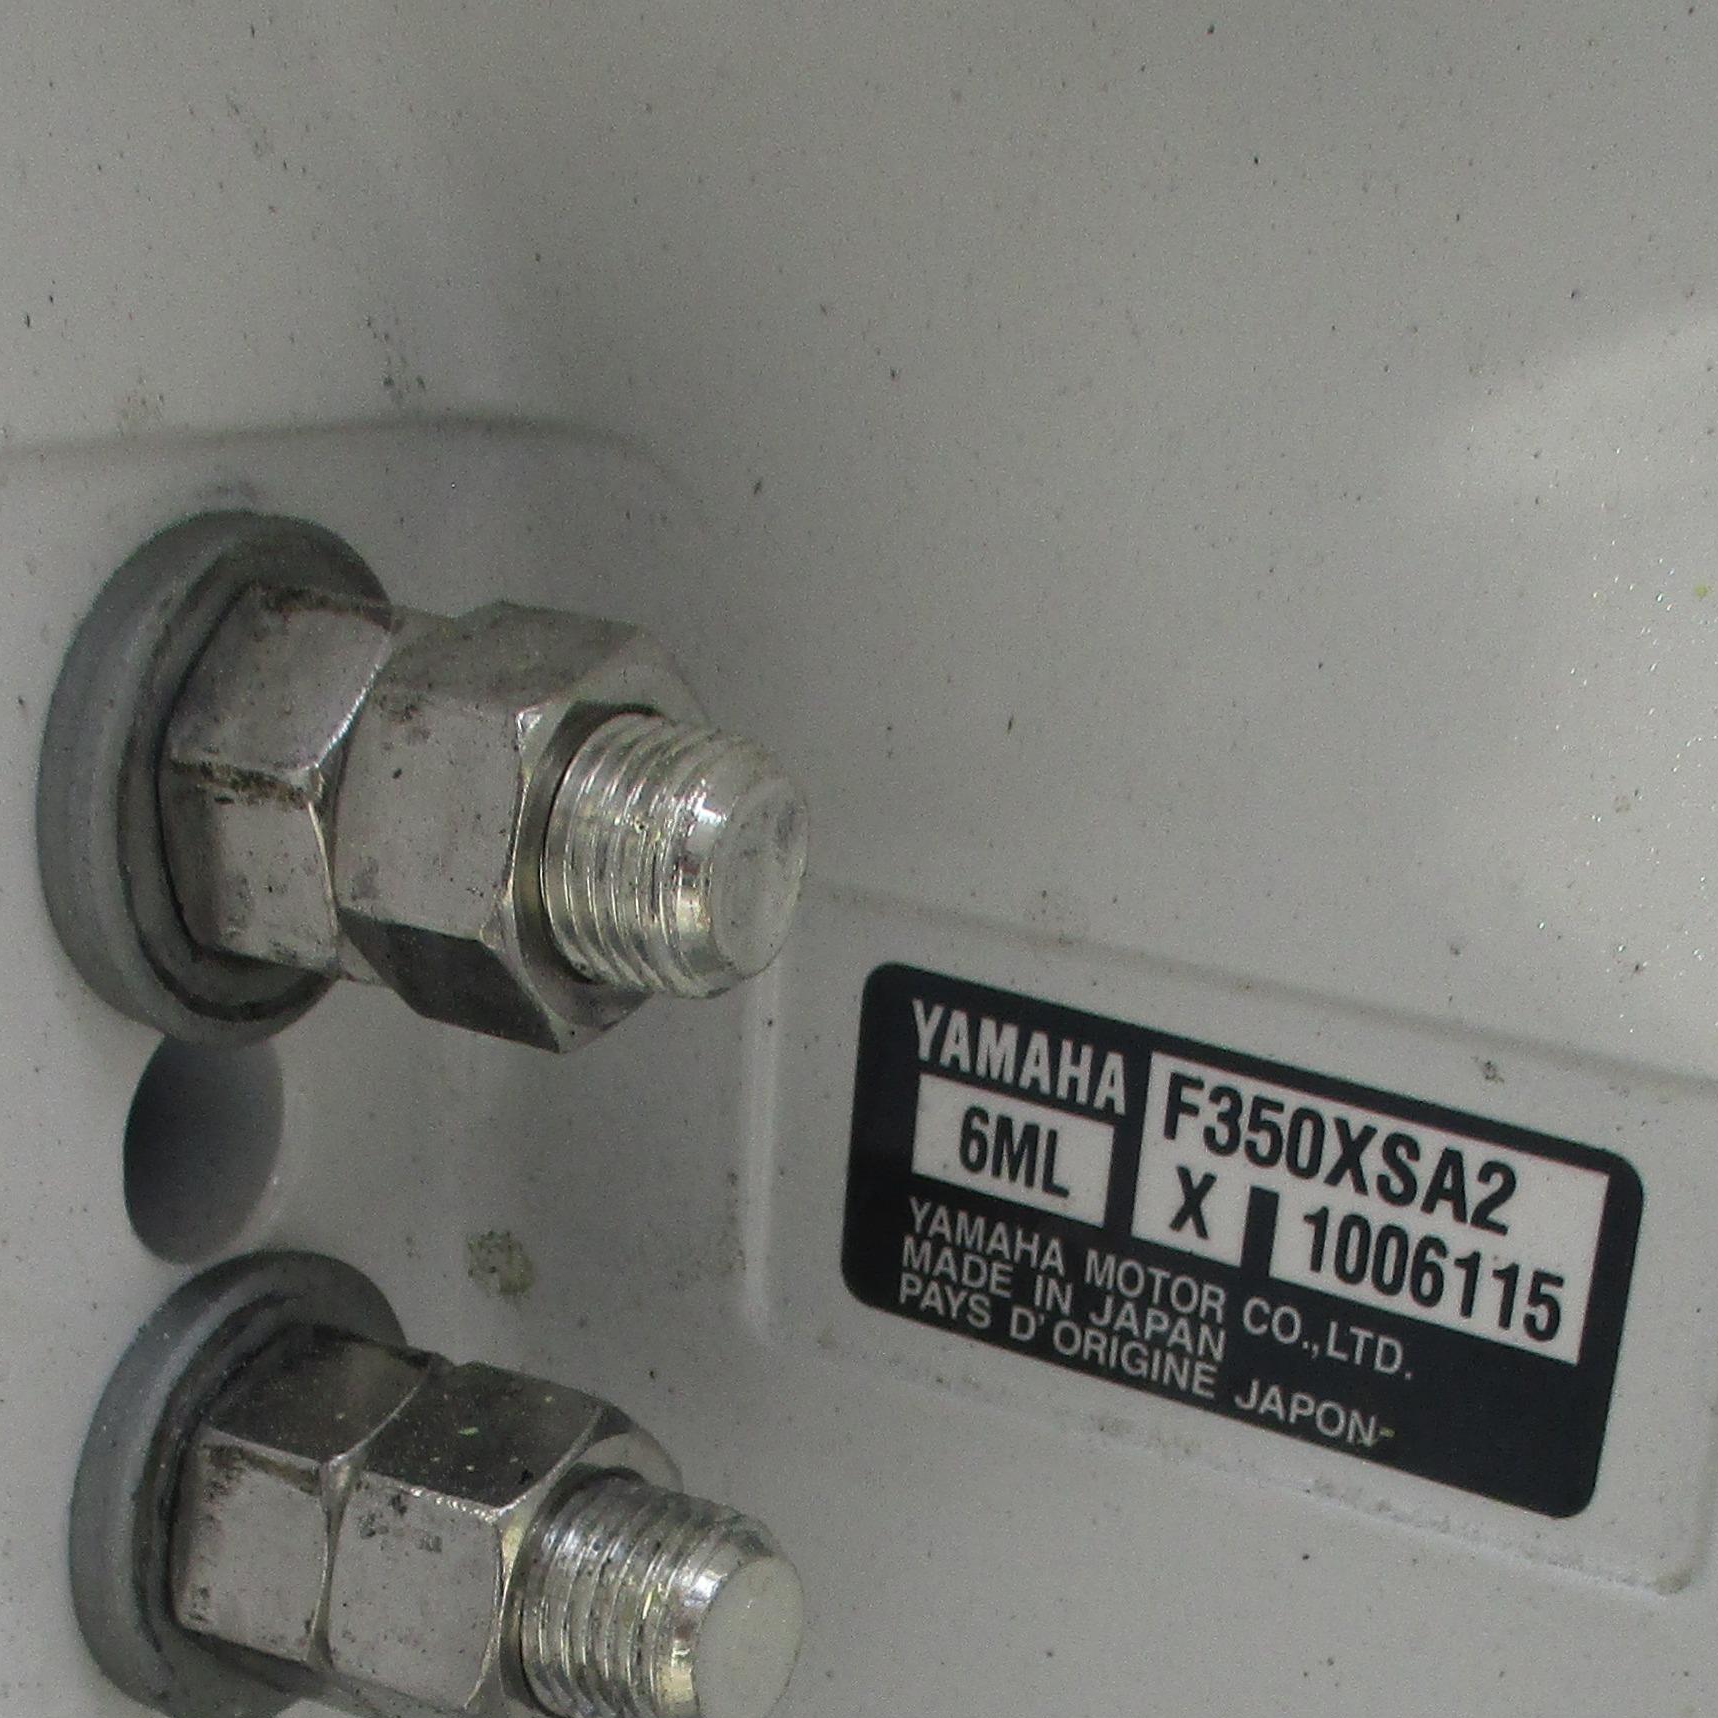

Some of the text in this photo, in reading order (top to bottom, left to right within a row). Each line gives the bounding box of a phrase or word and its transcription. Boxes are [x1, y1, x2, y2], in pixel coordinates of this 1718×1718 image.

[912, 998, 1127, 1116] YAMAHA
[959, 1104, 1070, 1199] 6ML
[1163, 1071, 1517, 1236] F350XSA2
[1169, 1165, 1218, 1240] X
[898, 1274, 992, 1331] PAYS
[901, 1235, 1226, 1363] MADE IN JAPAN
[908, 1196, 1066, 1276] YAMAHA
[1084, 1248, 1226, 1324] MOTOR
[1303, 1205, 1566, 1343] 1006115
